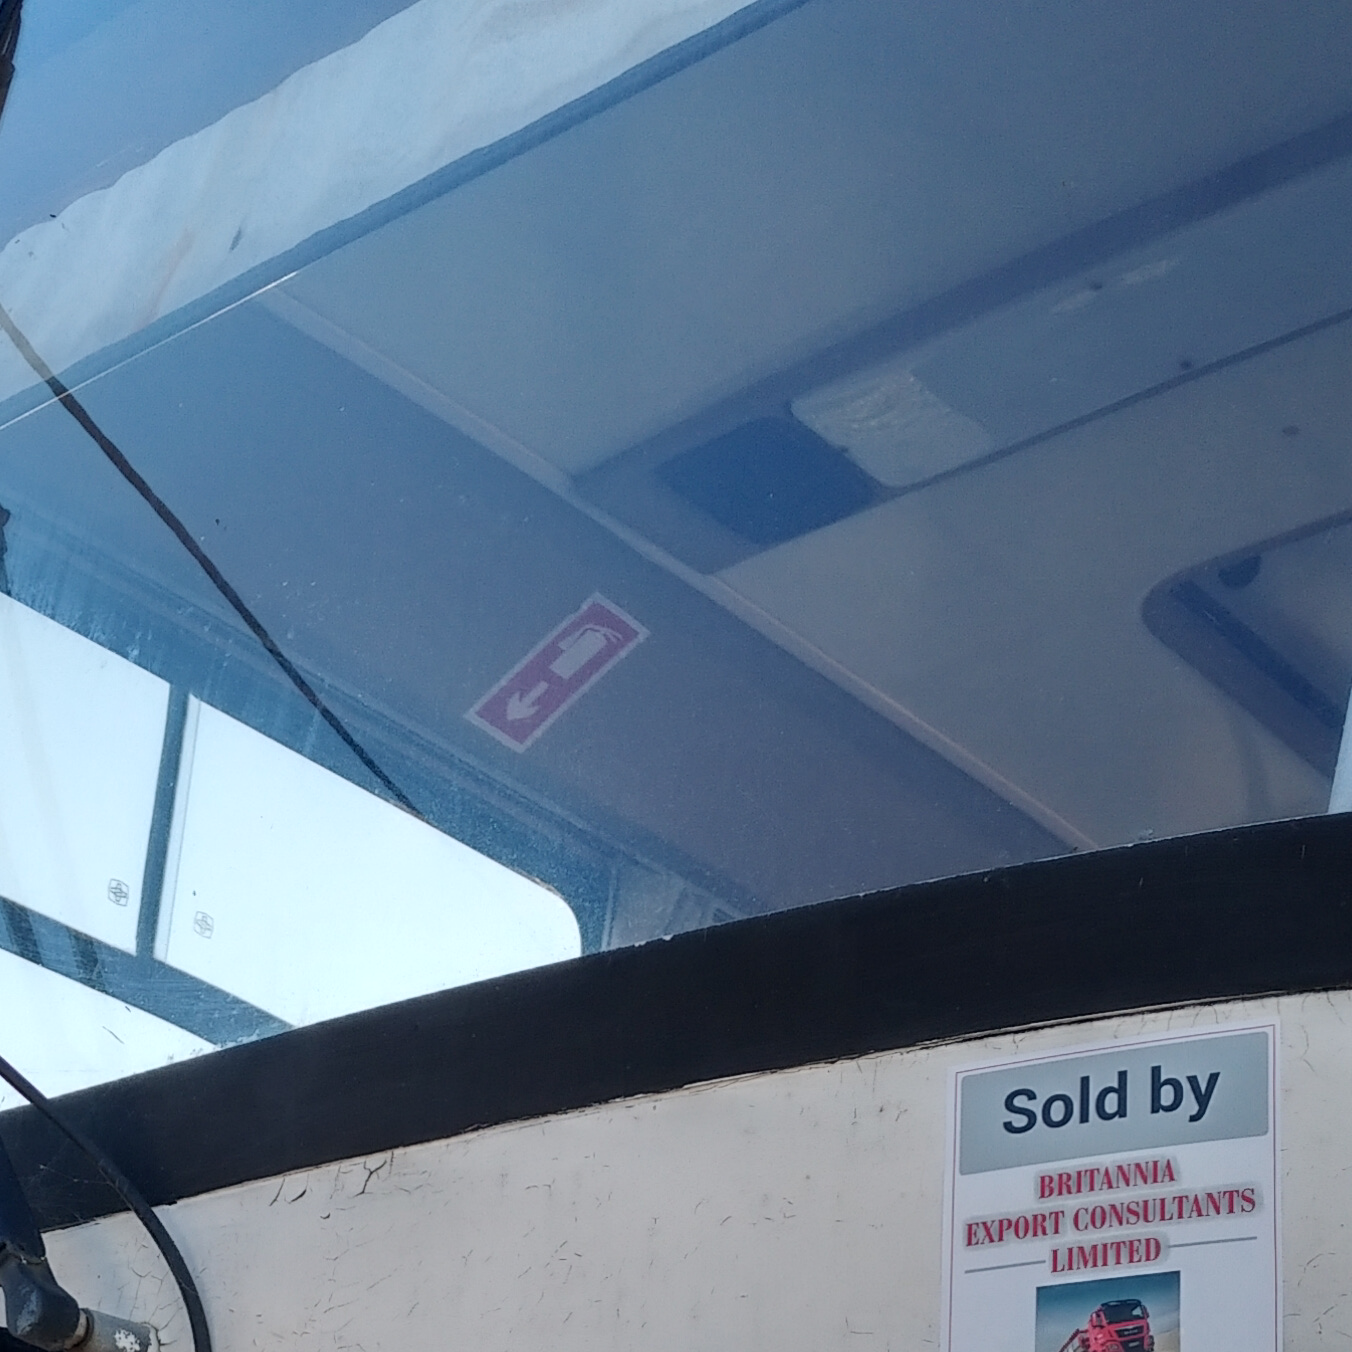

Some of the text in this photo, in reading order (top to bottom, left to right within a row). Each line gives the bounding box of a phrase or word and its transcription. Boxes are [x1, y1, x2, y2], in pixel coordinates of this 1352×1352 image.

[1002, 1064, 1221, 1135] Sold by
[1038, 1158, 1176, 1200] BRITANNIA
[965, 1188, 1256, 1247] EXPORT CONSULTANTS
[1050, 1237, 1162, 1274] LIMITED
